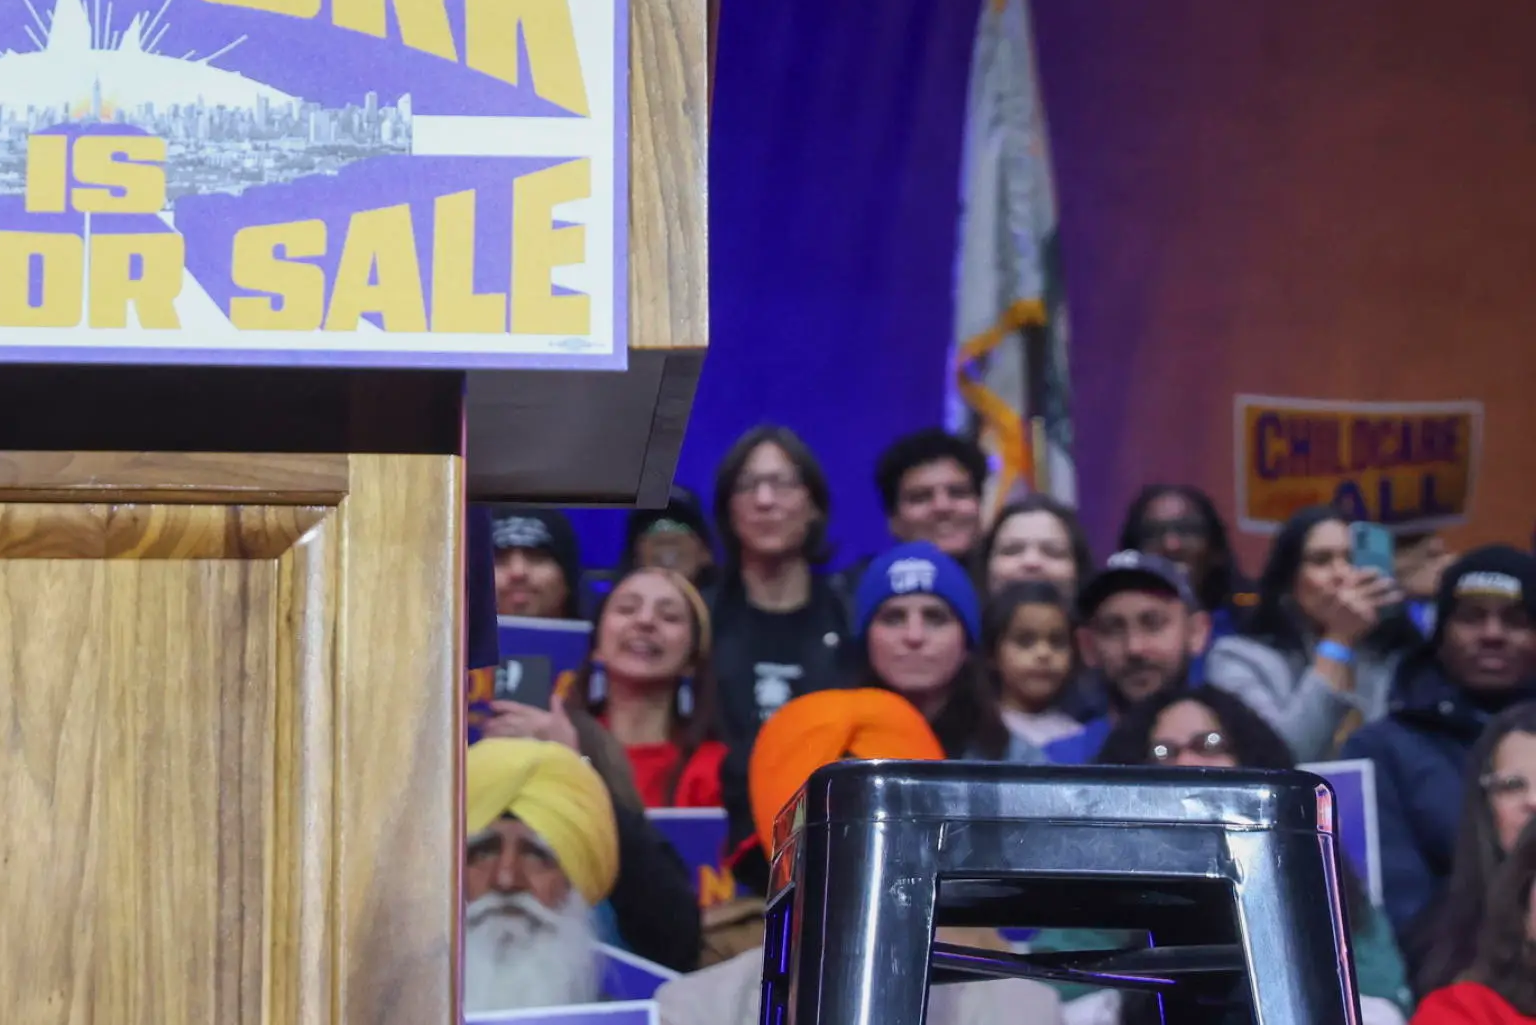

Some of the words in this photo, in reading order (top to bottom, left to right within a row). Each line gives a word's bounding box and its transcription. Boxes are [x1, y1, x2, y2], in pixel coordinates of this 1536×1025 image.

[26, 134, 166, 214] IS
[229, 158, 591, 335] SALE
[1255, 412, 1460, 480] CHILDCARE
[1332, 473, 1464, 523] ALL
